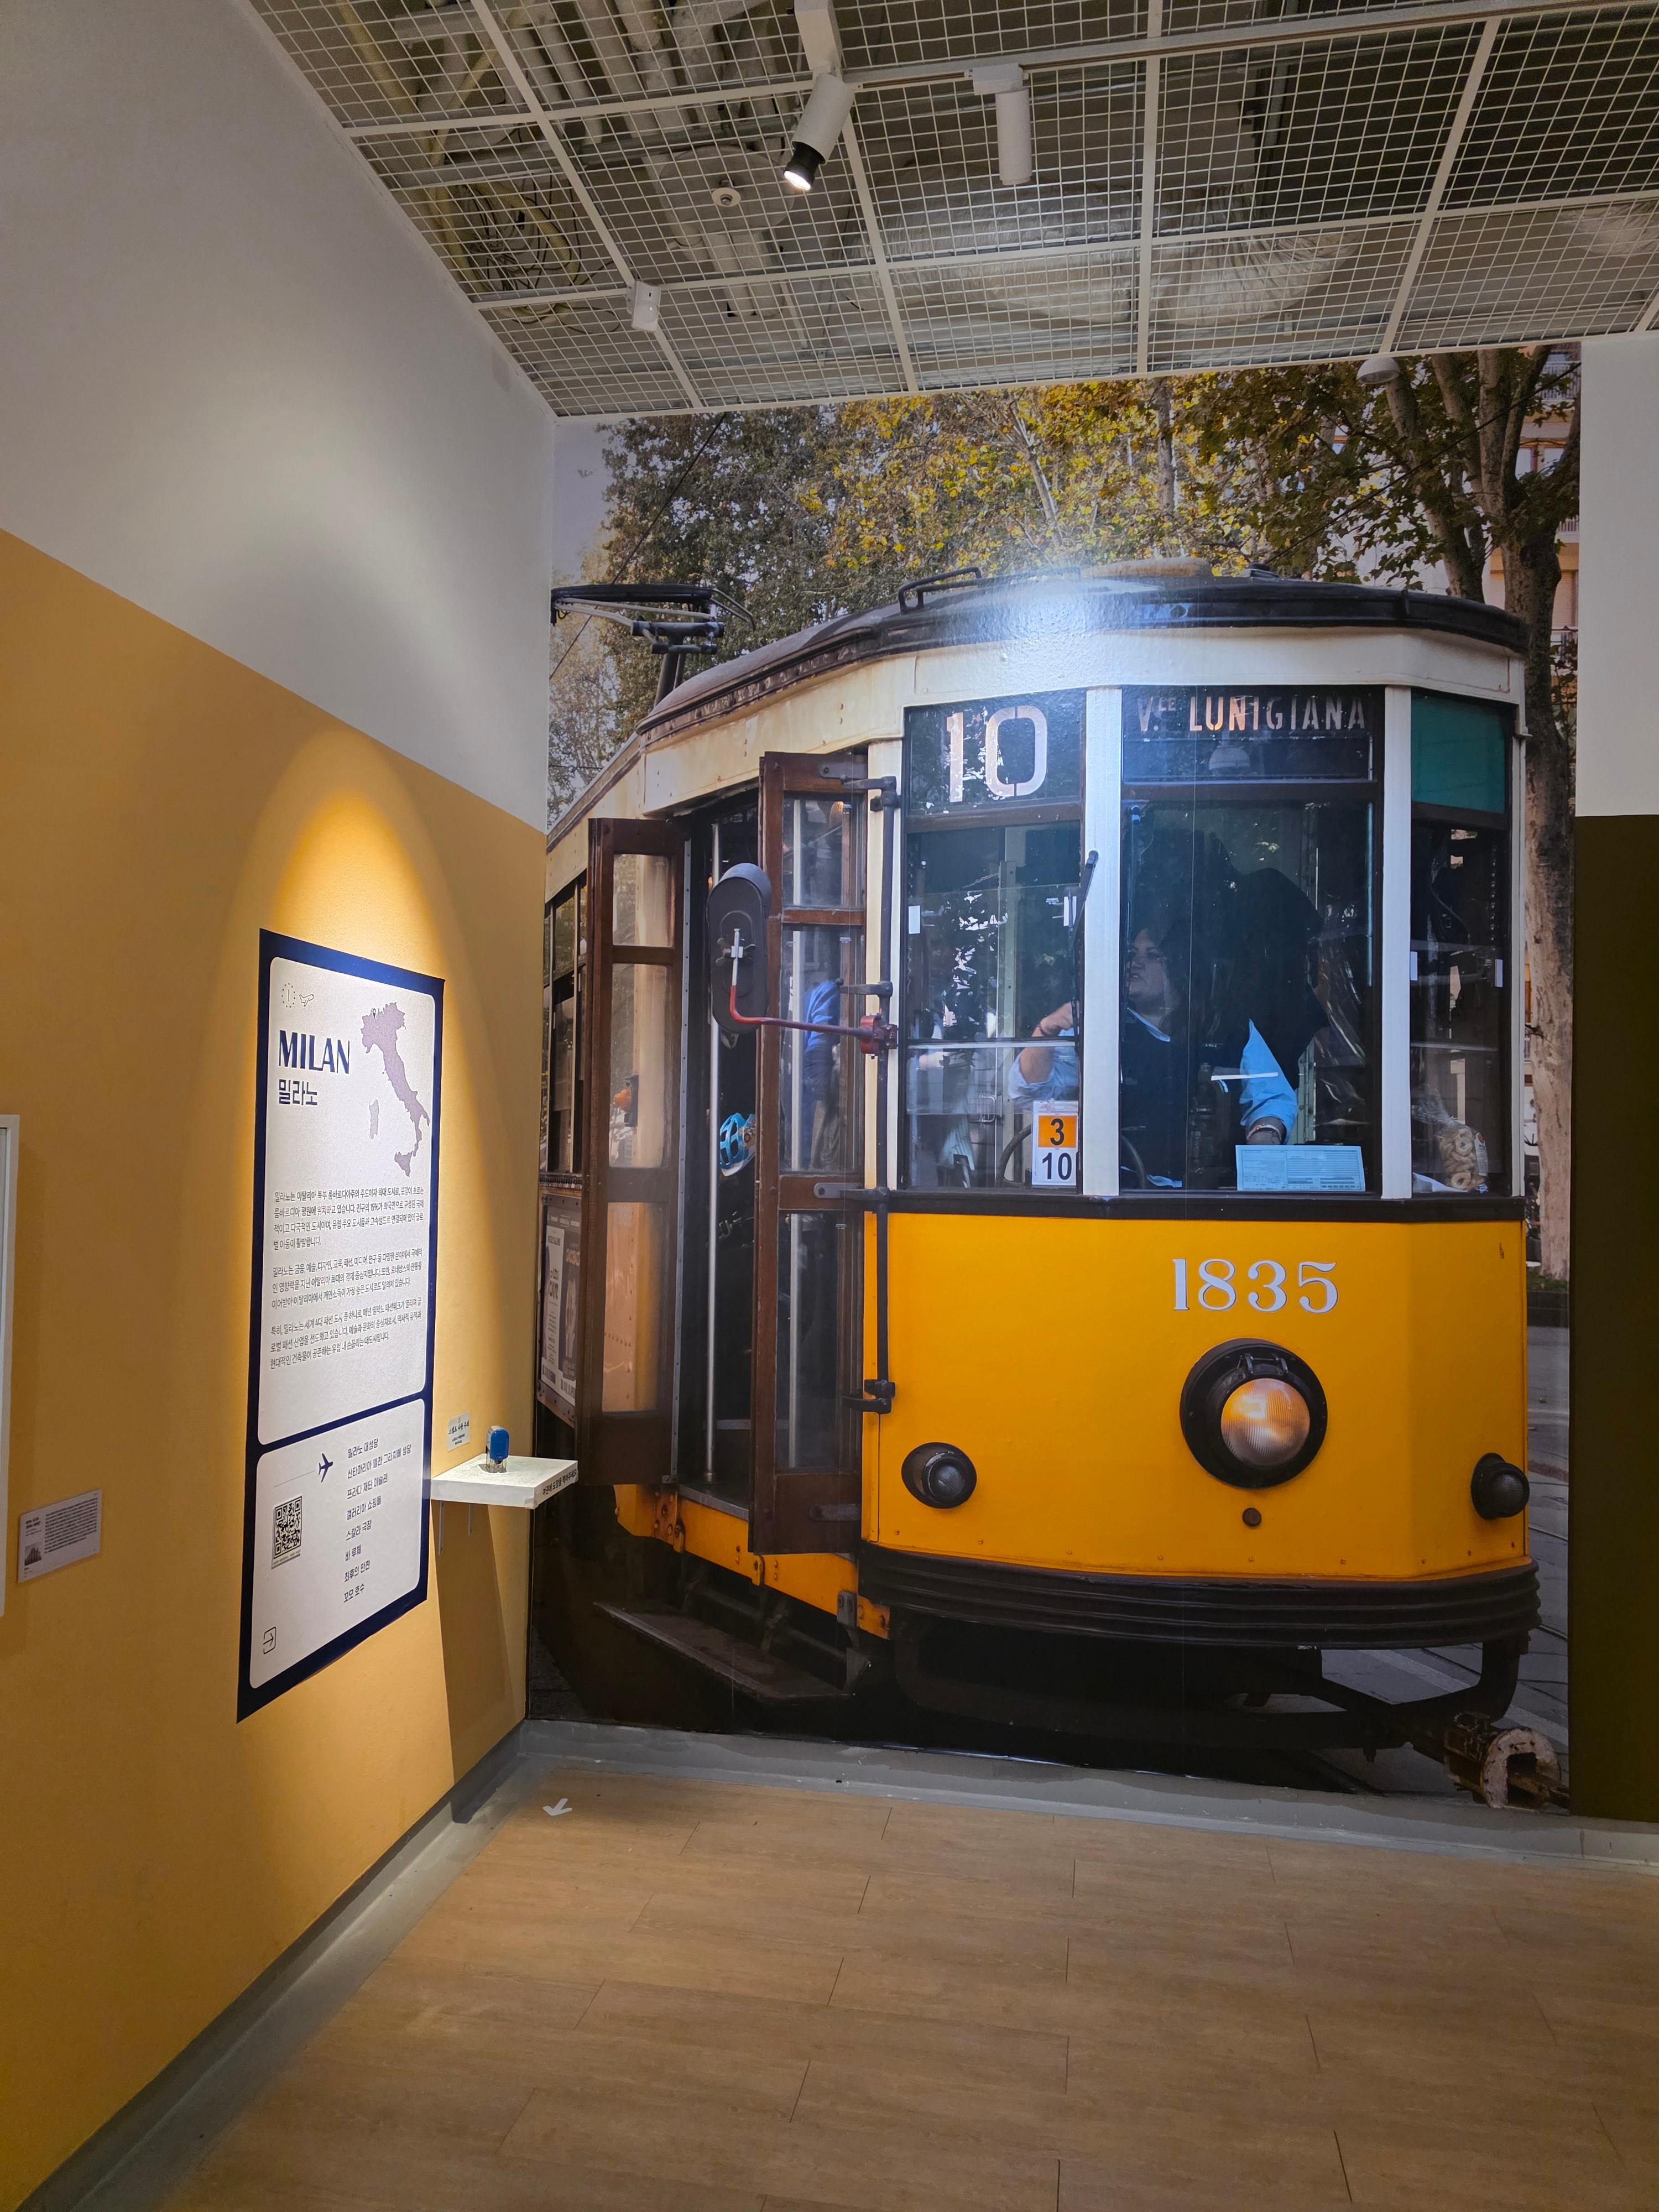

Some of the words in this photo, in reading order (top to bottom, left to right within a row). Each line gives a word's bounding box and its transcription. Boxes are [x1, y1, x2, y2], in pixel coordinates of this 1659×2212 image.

[1190, 695, 1365, 732] LUNIGIANA
[946, 705, 1047, 802] 10
[279, 1029, 349, 1074] MILAN
[278, 1078, 318, 1106] 밀라노
[1050, 1118, 1065, 1146] 3
[1042, 1152, 1072, 1181] 10
[274, 1191, 295, 1202] 밀라노는
[296, 1190, 316, 1201] 이탈리아
[413, 1186, 424, 1196] 흐르는
[301, 1206, 316, 1217] 평원에
[317, 1204, 336, 1215] 위치하고
[337, 1203, 355, 1214] 있습니다.
[356, 1203, 369, 1213] 인구의
[383, 1201, 403, 1211] 외국인으로
[274, 1223, 289, 1234] 적이고
[290, 1222, 310, 1233] 다국적인
[311, 1220, 331, 1231] 도시이며,
[332, 1219, 341, 1229] 유럽
[342, 1218, 351, 1228] 주요
[352, 1217, 369, 1228] 도시들과
[274, 1240, 279, 1250] 벌
[280, 1238, 295, 1250] 이동이
[296, 1236, 321, 1248] 활발합니다.
[273, 1265, 293, 1277] 밀라노는
[368, 1254, 377, 1264] 연구
[378, 1254, 382, 1263] 등
[272, 1282, 278, 1293] 인
[279, 1279, 299, 1292] 영향력을
[300, 1277, 310, 1289] 지닌
[311, 1275, 330, 1287] 이탈리아
[331, 1273, 344, 1285] 최대의
[345, 1271, 354, 1282] 경제
[1172, 1258, 1338, 1314] 1835
[272, 1296, 293, 1310] 이어받아
[294, 1291, 322, 1306] 이탈리아에서
[323, 1287, 345, 1301] 개인소득이
[346, 1286, 354, 1297] 가장
[356, 1284, 364, 1295] 높은
[283, 1320, 304, 1334] 밀라노는
[304, 1318, 314, 1330] 세계
[315, 1316, 322, 1328] 4대
[333, 1312, 342, 1324] 도시
[343, 1311, 348, 1322] 중
[363, 1307, 371, 1318] 매년
[270, 1340, 281, 1353] 로벌
[294, 1334, 309, 1348] 산업을
[310, 1330, 328, 1344] 선도하고
[329, 1326, 348, 1340] 있습니다.
[349, 1323, 361, 1335] 예술과
[362, 1320, 374, 1332] 문화의
[270, 1354, 290, 1369] 현대적인
[291, 1349, 311, 1364] 건축물이
[312, 1345, 331, 1359] 공존하는
[331, 1343, 340, 1354] 유럽
[342, 1342, 346, 1352] 내
[347, 1459, 372, 1479] 산타마리아
[383, 1448, 401, 1464] 그라치에
[402, 1443, 411, 1457] 성당
[348, 1443, 362, 1459] 밀라노
[364, 1437, 378, 1452] 대성당
[347, 1484, 362, 1500] 프라다
[363, 1479, 372, 1493] 재단
[374, 1473, 388, 1488] 미술관
[347, 1501, 366, 1520] 갤러리아
[367, 1495, 381, 1510] 쇼핑몰
[346, 1524, 361, 1541] 스칼라
[362, 1519, 371, 1533] 극장
[345, 1550, 350, 1562] 바
[351, 1544, 361, 1558] 루체
[344, 1565, 359, 1583] 최후의
[360, 1559, 370, 1574] 만찬
[354, 1582, 364, 1597] 호수
